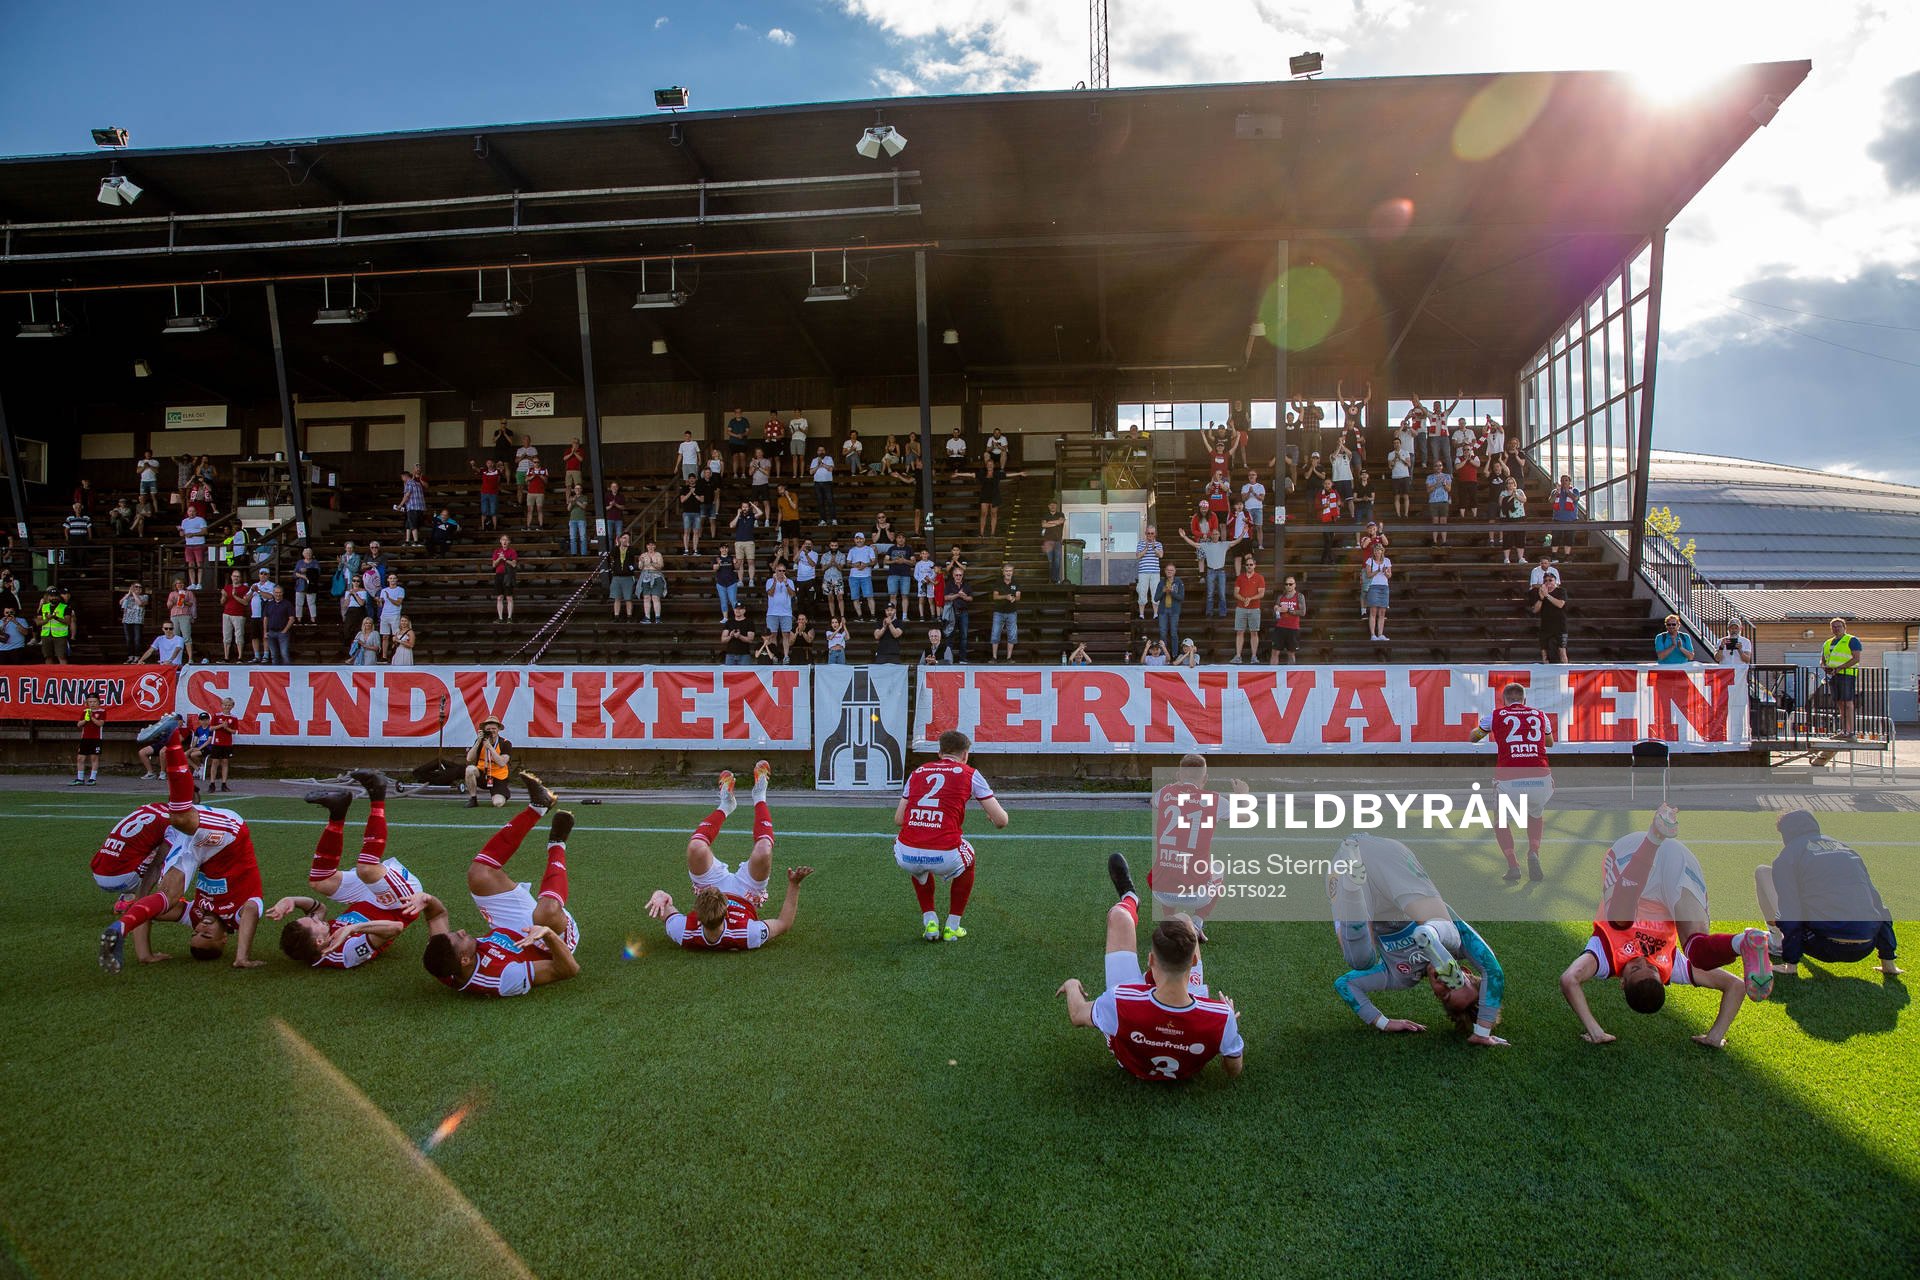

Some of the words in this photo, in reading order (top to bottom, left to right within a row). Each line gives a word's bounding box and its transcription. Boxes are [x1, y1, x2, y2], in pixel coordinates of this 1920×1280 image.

[19, 677, 124, 706] FLANKEN
[187, 670, 799, 741] SANDVIKEN
[1503, 715, 1542, 744] 23
[917, 773, 945, 807] 2
[111, 809, 157, 838] 18
[1160, 805, 1203, 849] 21
